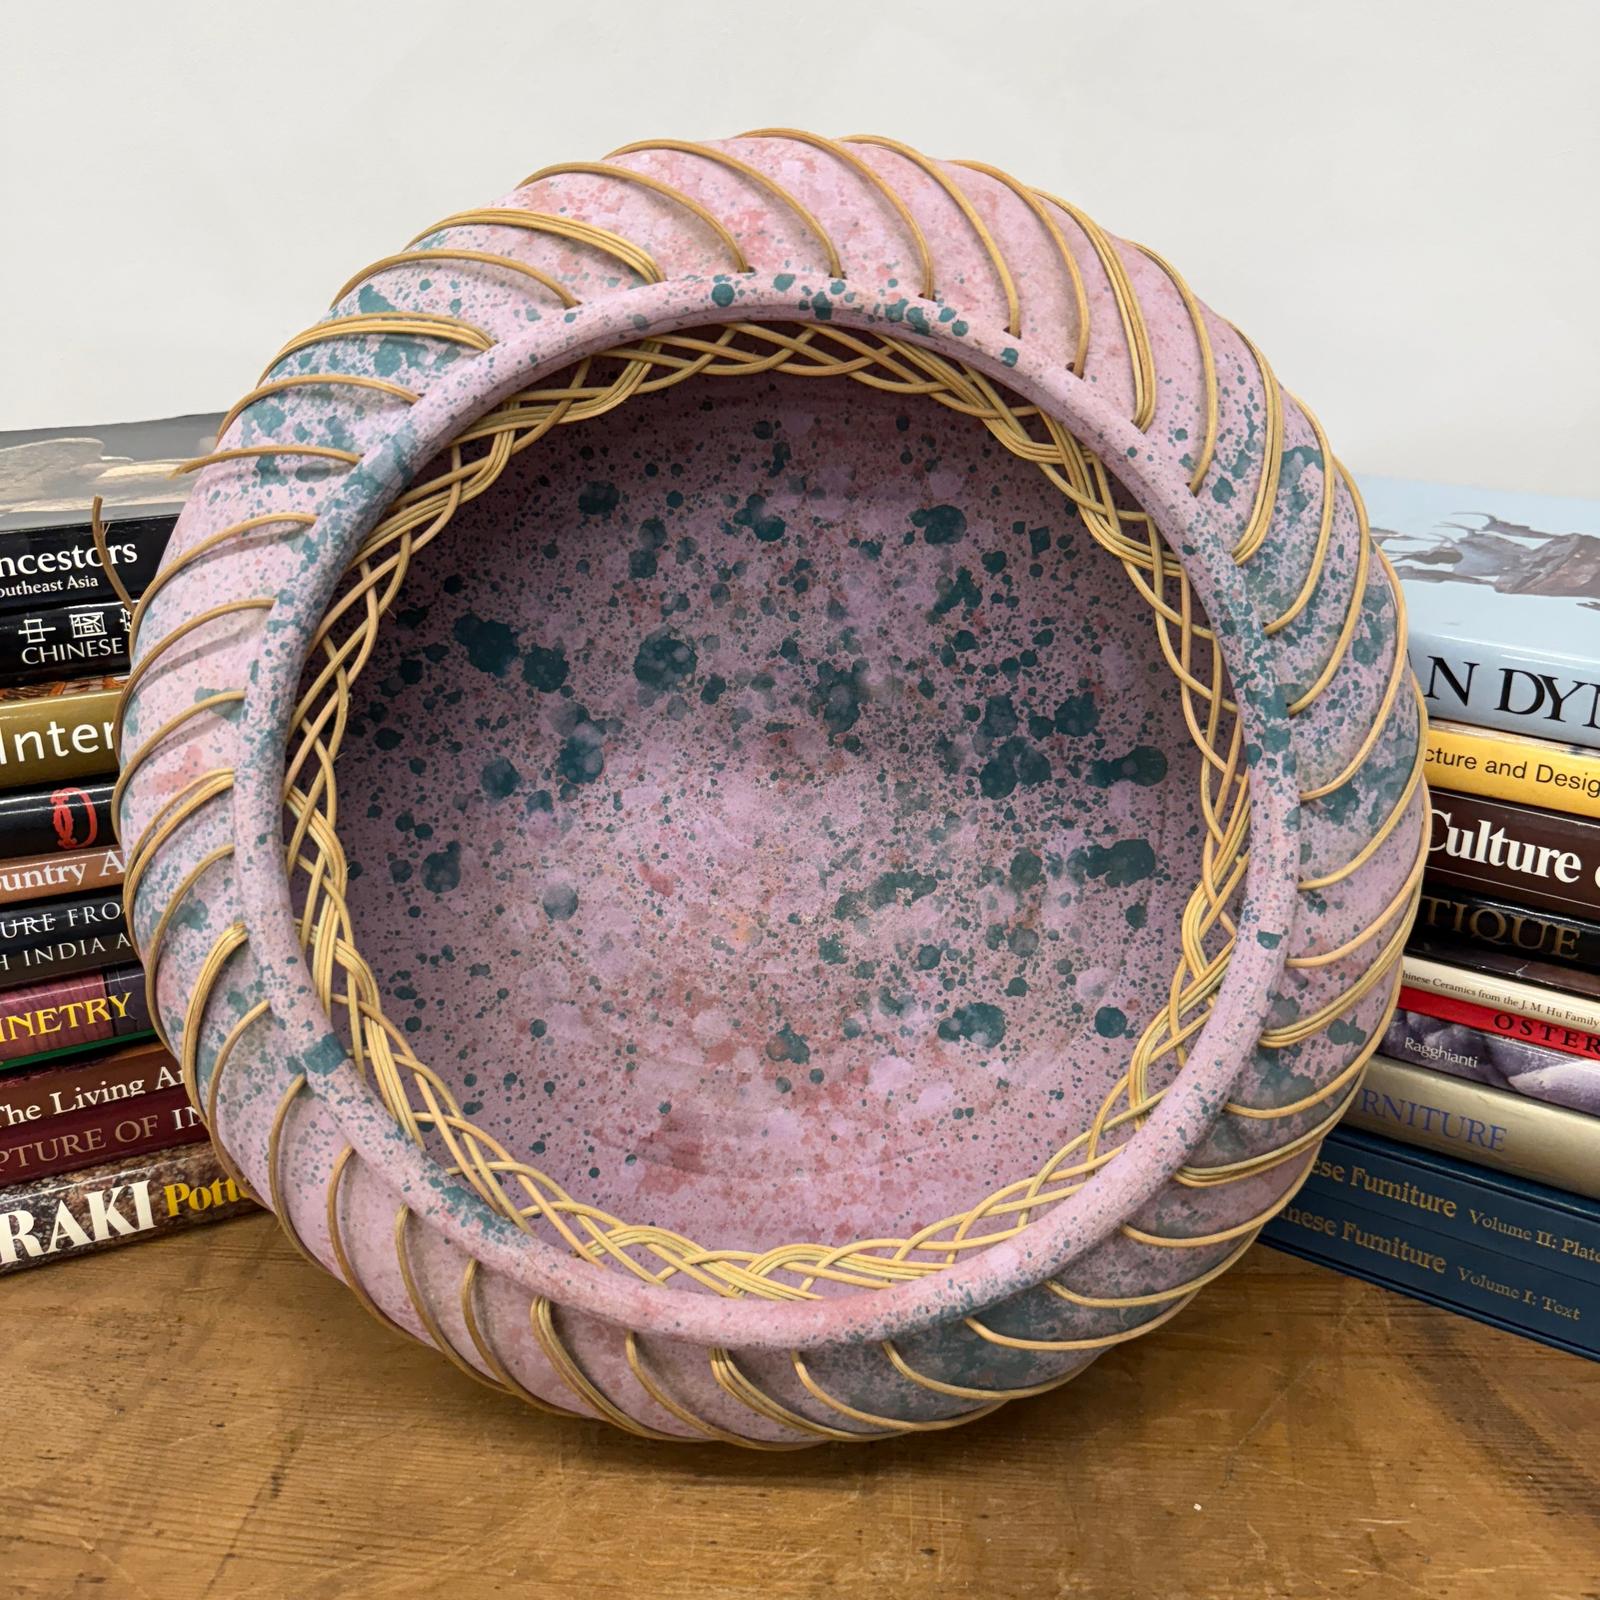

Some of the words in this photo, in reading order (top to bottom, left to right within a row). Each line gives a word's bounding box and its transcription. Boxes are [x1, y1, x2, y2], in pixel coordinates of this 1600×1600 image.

[0, 543, 138, 578] ncestors
[67, 575, 99, 590] Asia
[21, 637, 125, 665] CHINESE
[1407, 649, 1480, 707] N
[1493, 668, 1600, 730] DY
[1485, 761, 1528, 780] and
[1429, 808, 1583, 884] Culture
[0, 862, 86, 892] untry
[68, 901, 125, 927] FRO
[1420, 895, 1582, 960] TIQUE
[24, 937, 107, 967] INDIA
[1432, 978, 1477, 998] Ceramics
[1478, 989, 1501, 1003] from
[1503, 996, 1519, 1008] the
[1519, 1000, 1528, 1011] J.
[1530, 1002, 1545, 1014] M.
[1546, 1006, 1563, 1019] Hu
[1565, 1011, 1600, 1030] Family
[1404, 1037, 1479, 1070] Ragghianti
[49, 1081, 146, 1115] Living
[115, 1115, 159, 1143] OF
[0, 1180, 158, 1266] RAKI
[1350, 1166, 1458, 1218] Furniture
[1469, 1209, 1532, 1241] Volume
[1536, 1230, 1557, 1249] II:
[1341, 1220, 1448, 1274] Furniture
[1457, 1266, 1519, 1299] Volume
[1522, 1288, 1537, 1306] I:
[1541, 1295, 1582, 1322] Text
